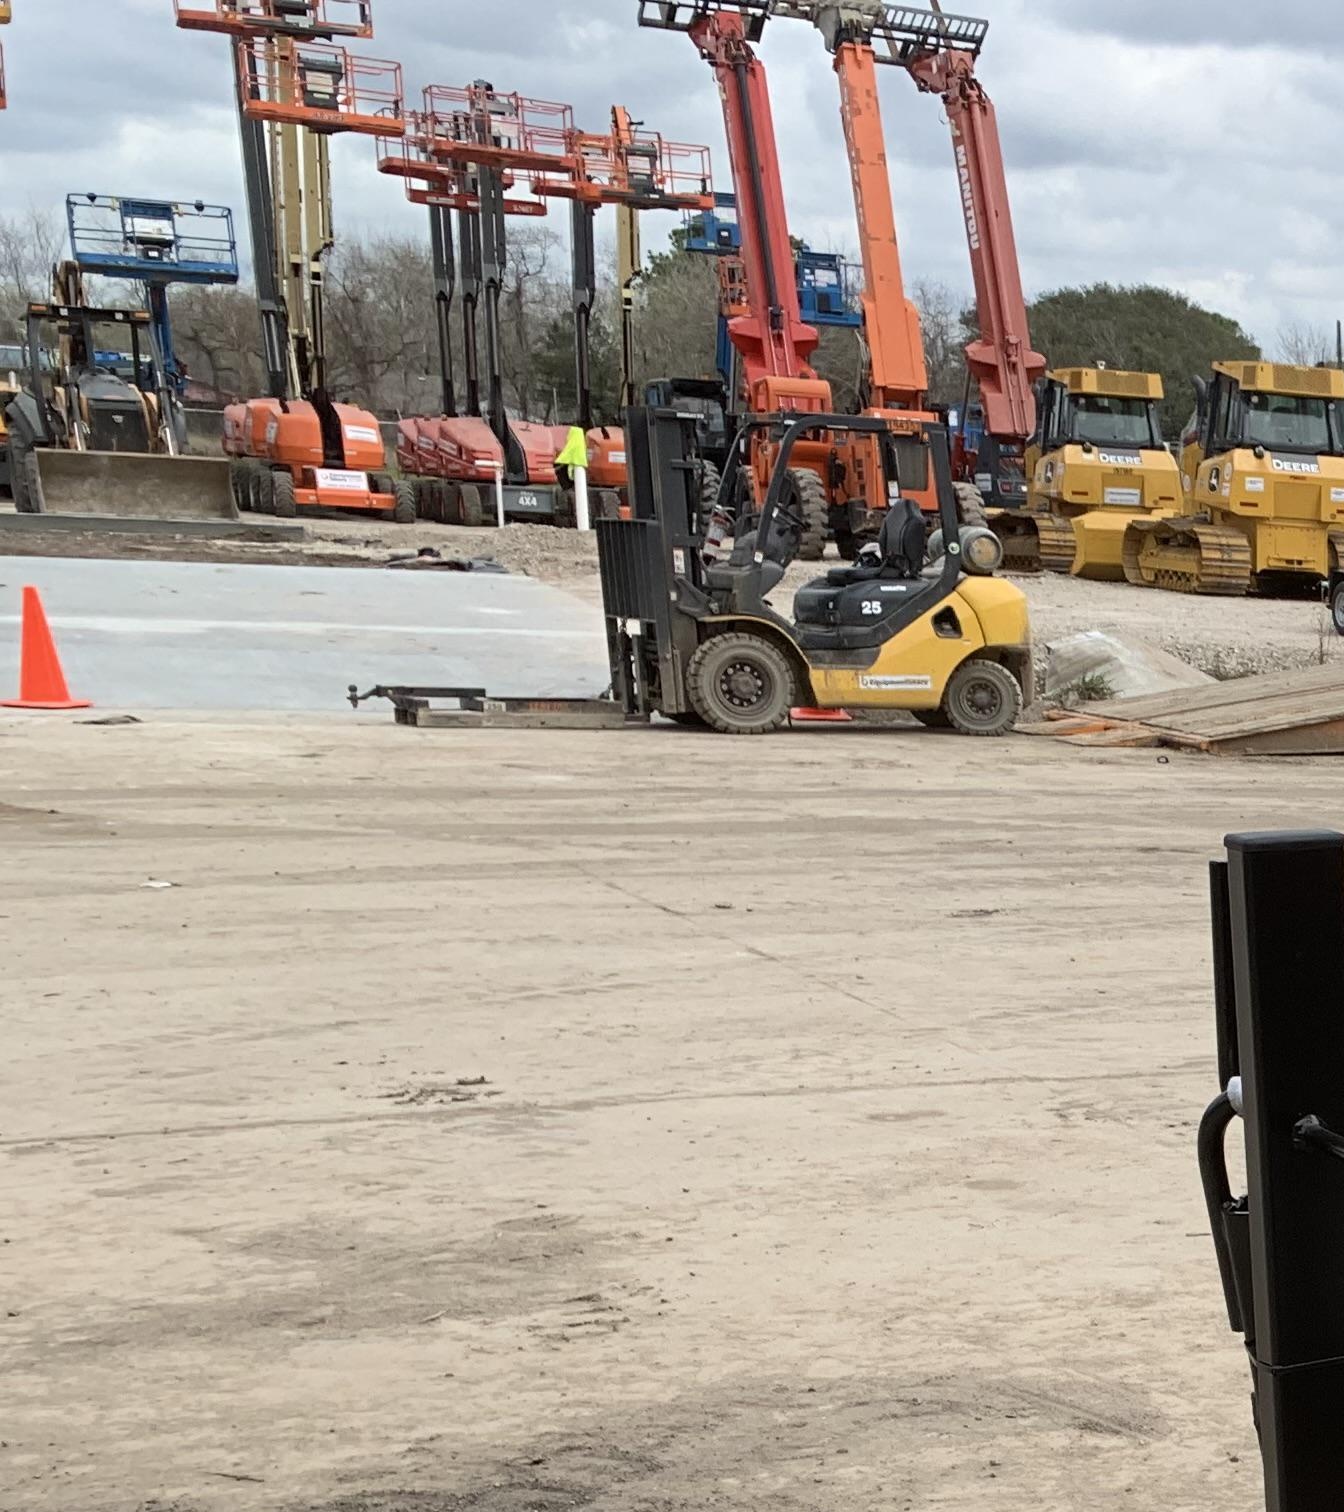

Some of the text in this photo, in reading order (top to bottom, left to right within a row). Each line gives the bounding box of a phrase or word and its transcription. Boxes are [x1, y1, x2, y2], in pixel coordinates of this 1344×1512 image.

[955, 144, 980, 250] MANITOU
[1098, 452, 1143, 465] DEERE
[1272, 458, 1321, 474] DEERE
[518, 496, 538, 506] 4X4
[861, 600, 882, 615] 25
